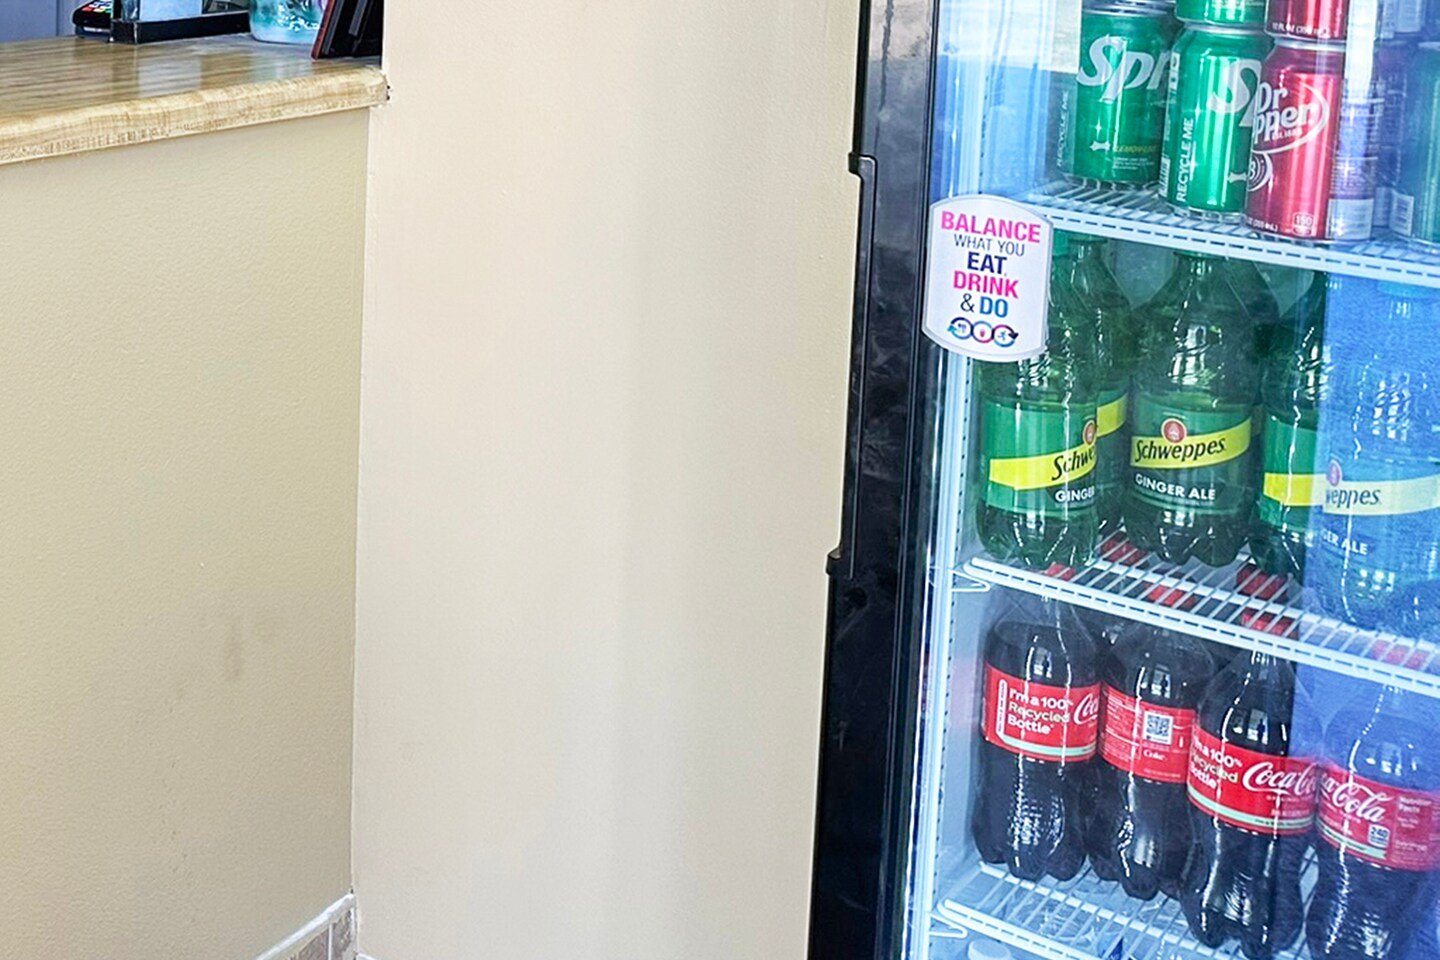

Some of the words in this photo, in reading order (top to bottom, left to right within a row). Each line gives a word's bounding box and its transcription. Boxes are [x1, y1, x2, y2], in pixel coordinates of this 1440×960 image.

[1182, 117, 1194, 141] ME
[1253, 102, 1318, 145] pper
[1175, 141, 1191, 203] RECYCLE
[940, 210, 1042, 244] BALANCE
[953, 233, 993, 252] WHAT
[996, 240, 1026, 258] YOU
[953, 270, 1020, 299] DRINK
[960, 292, 975, 313] &
[979, 296, 1009, 319] DO
[1134, 437, 1227, 463] Schweppes
[1134, 472, 1186, 497] GINGER
[1189, 487, 1216, 501] ALE
